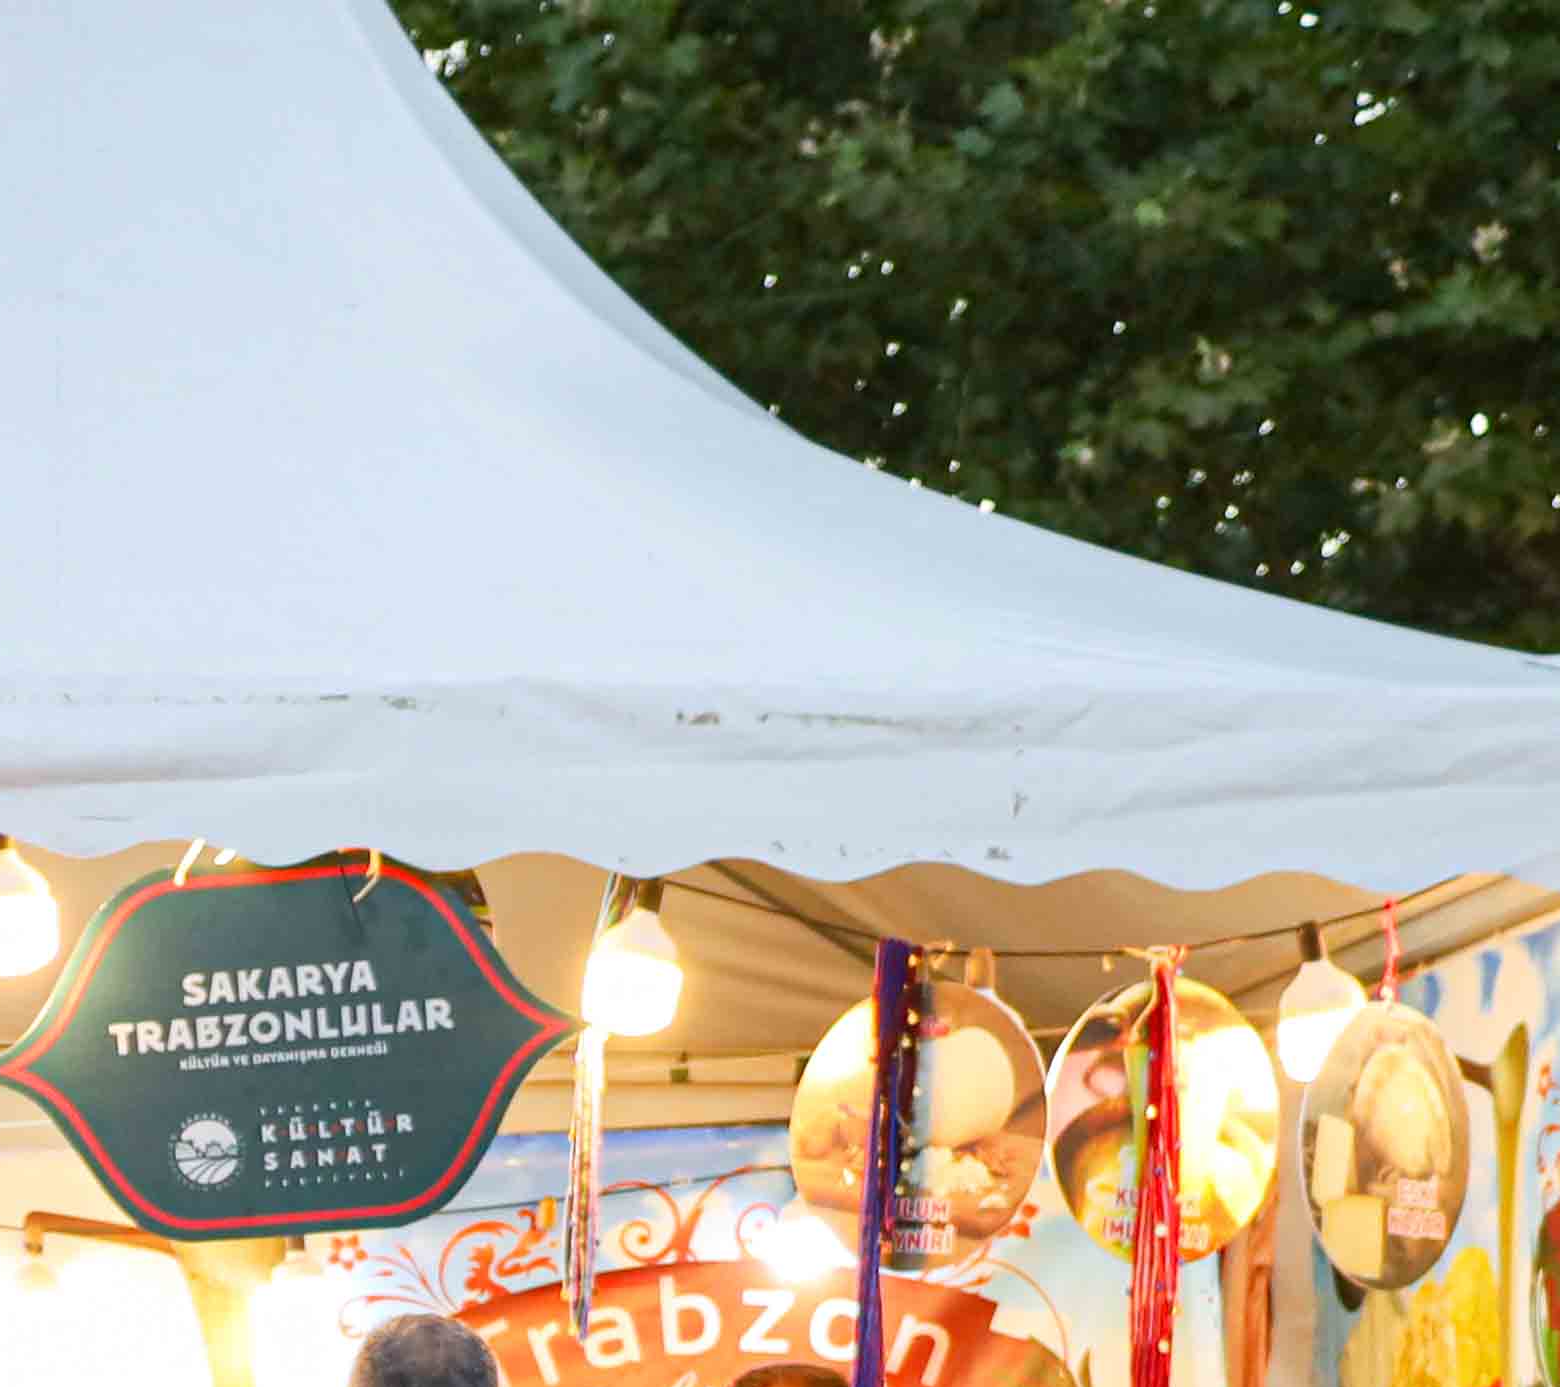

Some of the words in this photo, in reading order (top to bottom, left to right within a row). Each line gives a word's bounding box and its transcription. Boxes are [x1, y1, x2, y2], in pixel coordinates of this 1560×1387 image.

[181, 959, 377, 1008] SAKARYA
[108, 999, 456, 1057] TRABZONLULAR
[179, 1054, 229, 1071] KÜLTÜR
[233, 1054, 249, 1066] VE
[252, 1051, 327, 1065] DAYANIŞMA
[330, 1041, 388, 1060] DERNEĞİ
[261, 1111, 414, 1144] KÜLTÜR
[263, 1144, 387, 1172] SANAT
